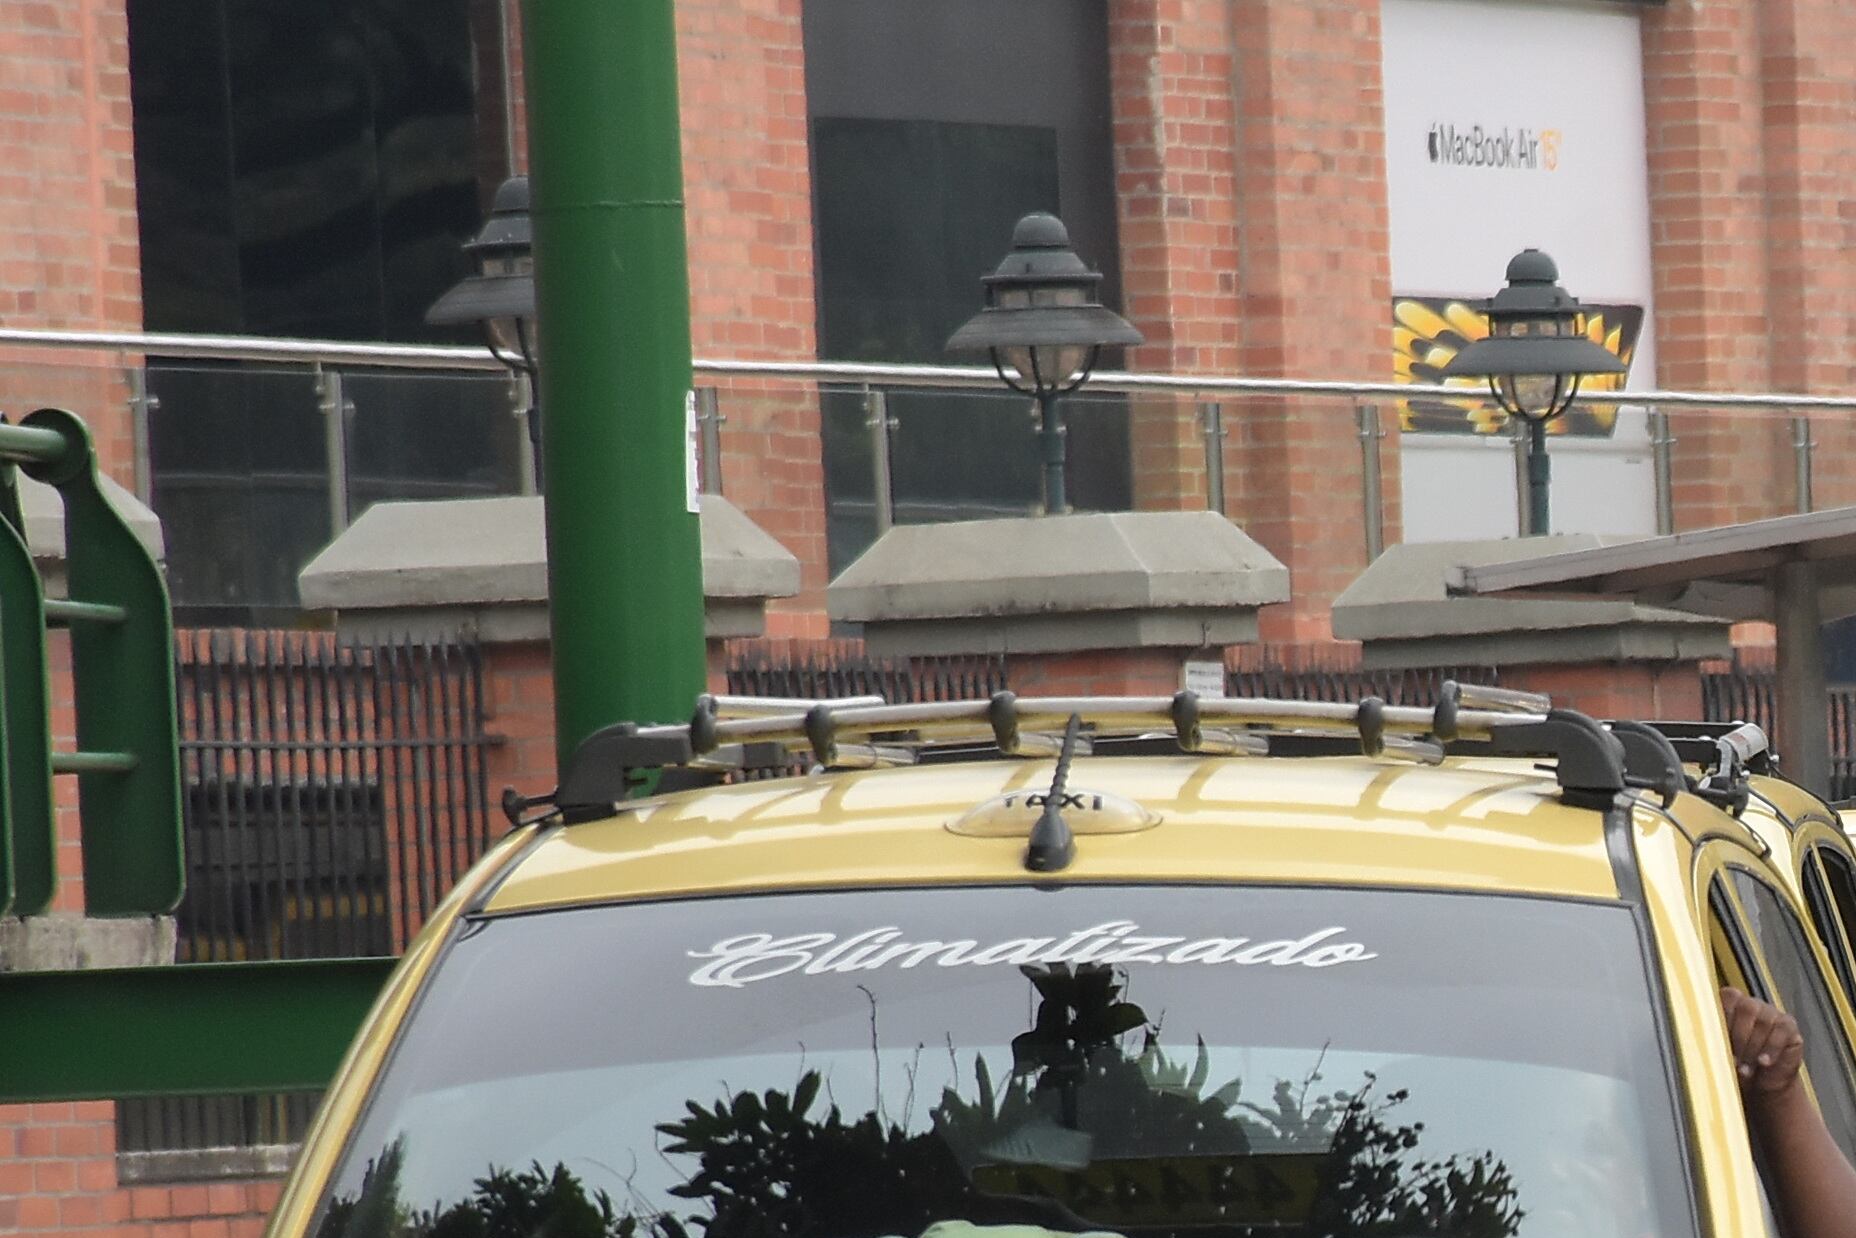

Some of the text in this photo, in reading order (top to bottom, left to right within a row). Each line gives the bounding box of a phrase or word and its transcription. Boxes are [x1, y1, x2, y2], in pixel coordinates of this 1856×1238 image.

[1439, 124, 1514, 168] MacBook
[1517, 128, 1539, 169] Air
[1004, 793, 1103, 811] TAXI
[687, 920, 1378, 988] Climatizado
